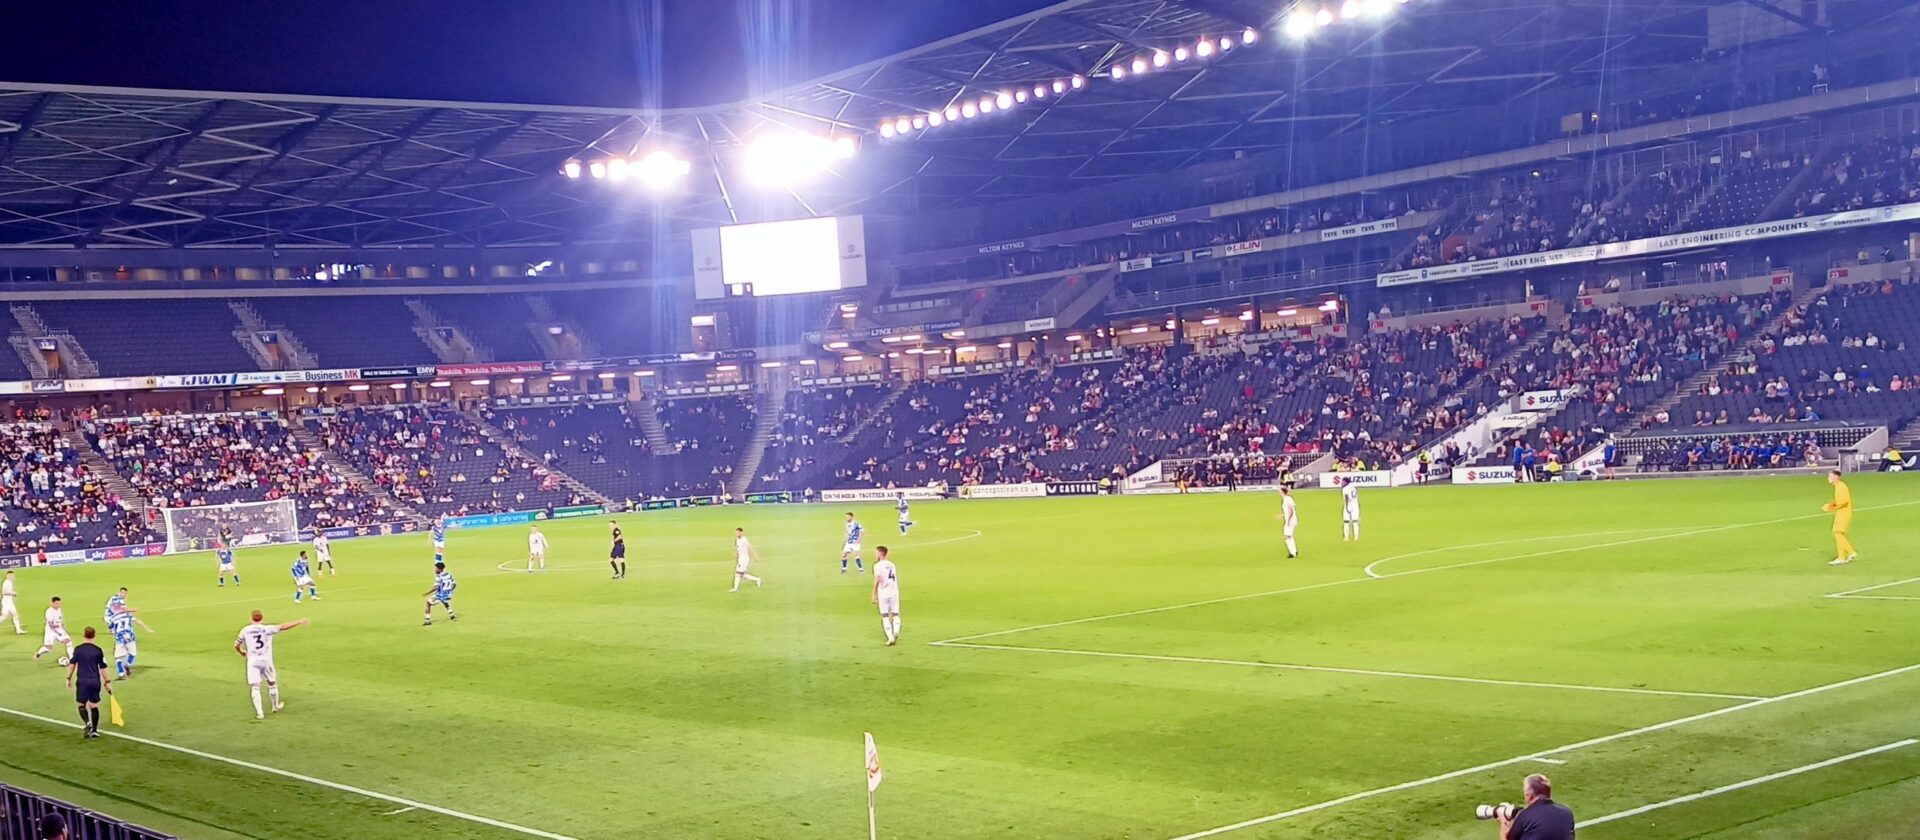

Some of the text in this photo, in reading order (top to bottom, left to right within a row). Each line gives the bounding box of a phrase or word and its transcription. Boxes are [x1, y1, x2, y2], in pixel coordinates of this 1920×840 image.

[1131, 214, 1177, 229] MILTON KEYNES
[1681, 230, 1742, 244] ENGINEERING
[978, 241, 1025, 253] MILTON KEYNES
[1232, 240, 1260, 252] LILIN
[1510, 258, 1527, 267] EAST
[870, 327, 892, 336] LYNX
[305, 370, 343, 380] Business
[344, 369, 359, 378] MK
[1349, 475, 1377, 483] UZUKI
[1059, 484, 1098, 493] CASTORE
[92, 551, 105, 559] sky
[131, 547, 145, 555] sky
[888, 569, 896, 582] 4
[253, 635, 264, 650] 3
